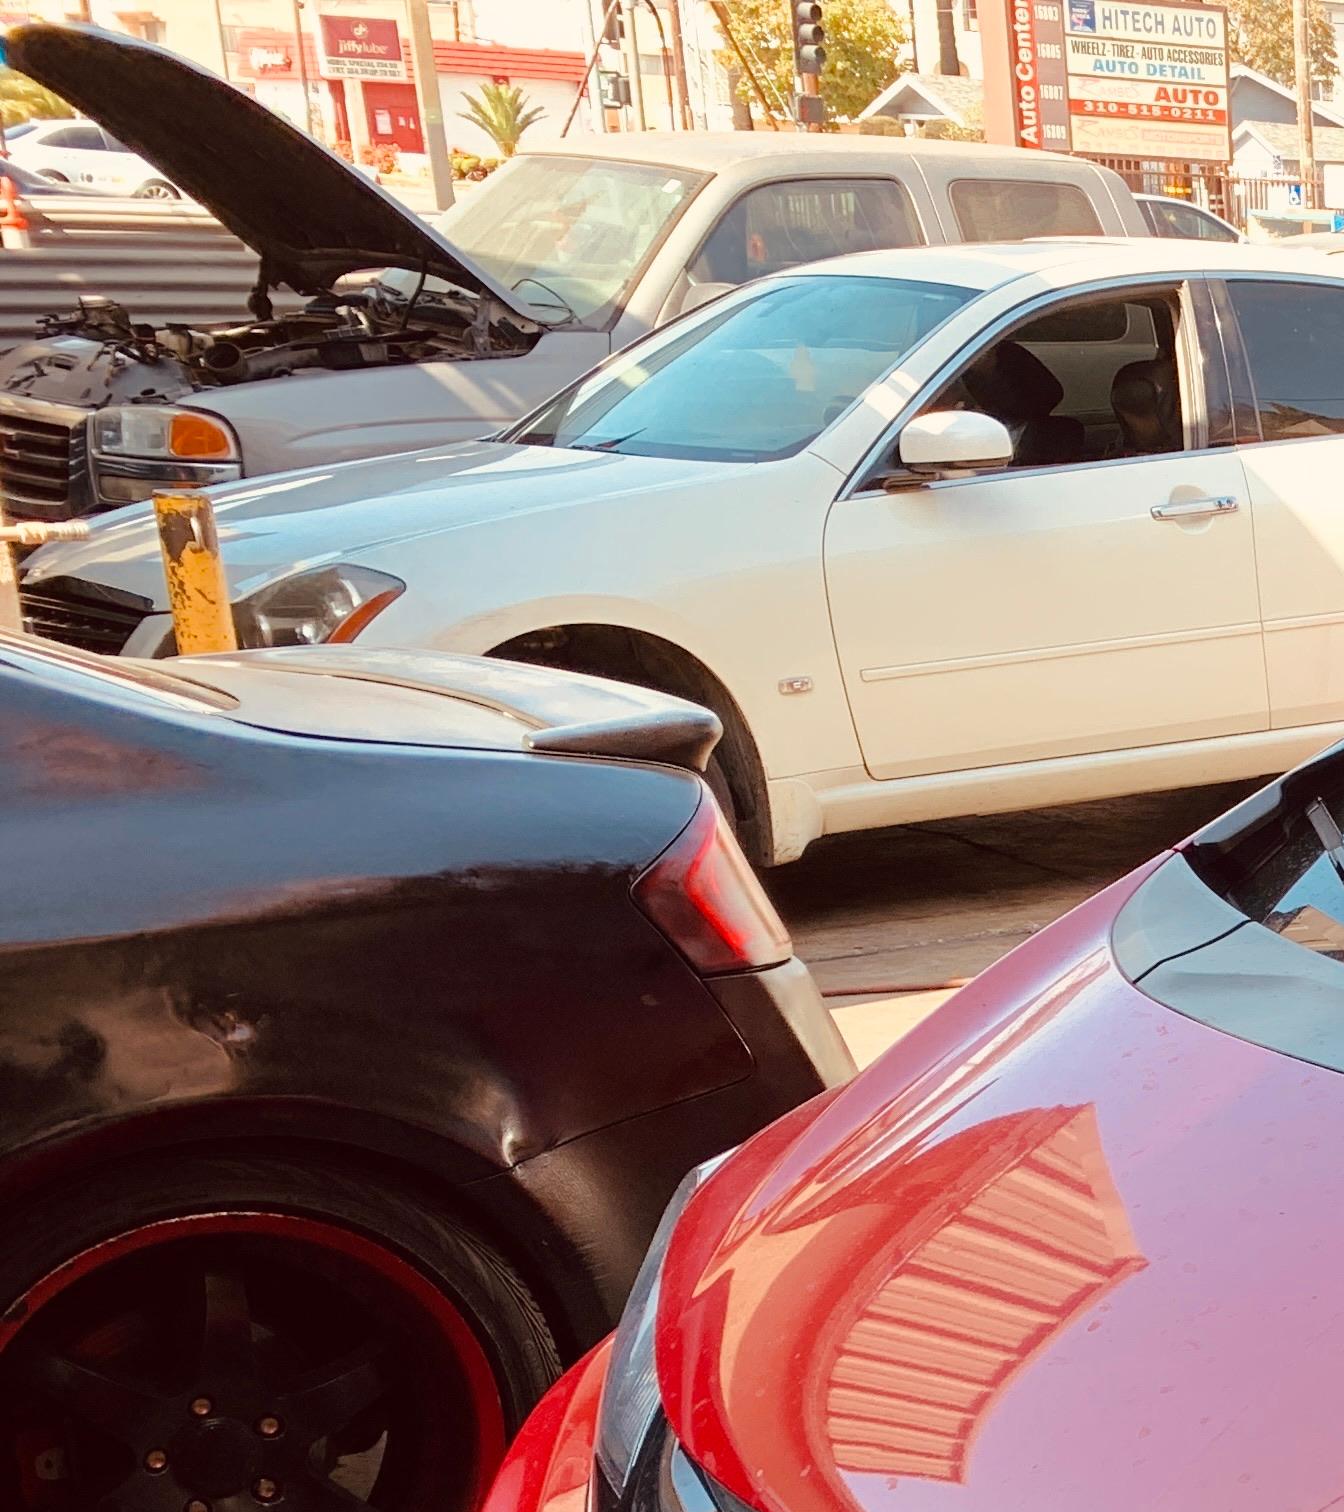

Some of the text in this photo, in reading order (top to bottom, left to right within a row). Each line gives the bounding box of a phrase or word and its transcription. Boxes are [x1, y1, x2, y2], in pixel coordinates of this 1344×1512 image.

[1102, 8, 1165, 35] HITECH
[1172, 14, 1217, 39] AUTO
[1167, 48, 1224, 66] ACCESSORIES
[1093, 59, 1206, 81] AUTO DETAIL
[1154, 86, 1219, 106] AUTO
[1019, 85, 1038, 144] Auto
[1083, 101, 1217, 121] 310-515-0211
